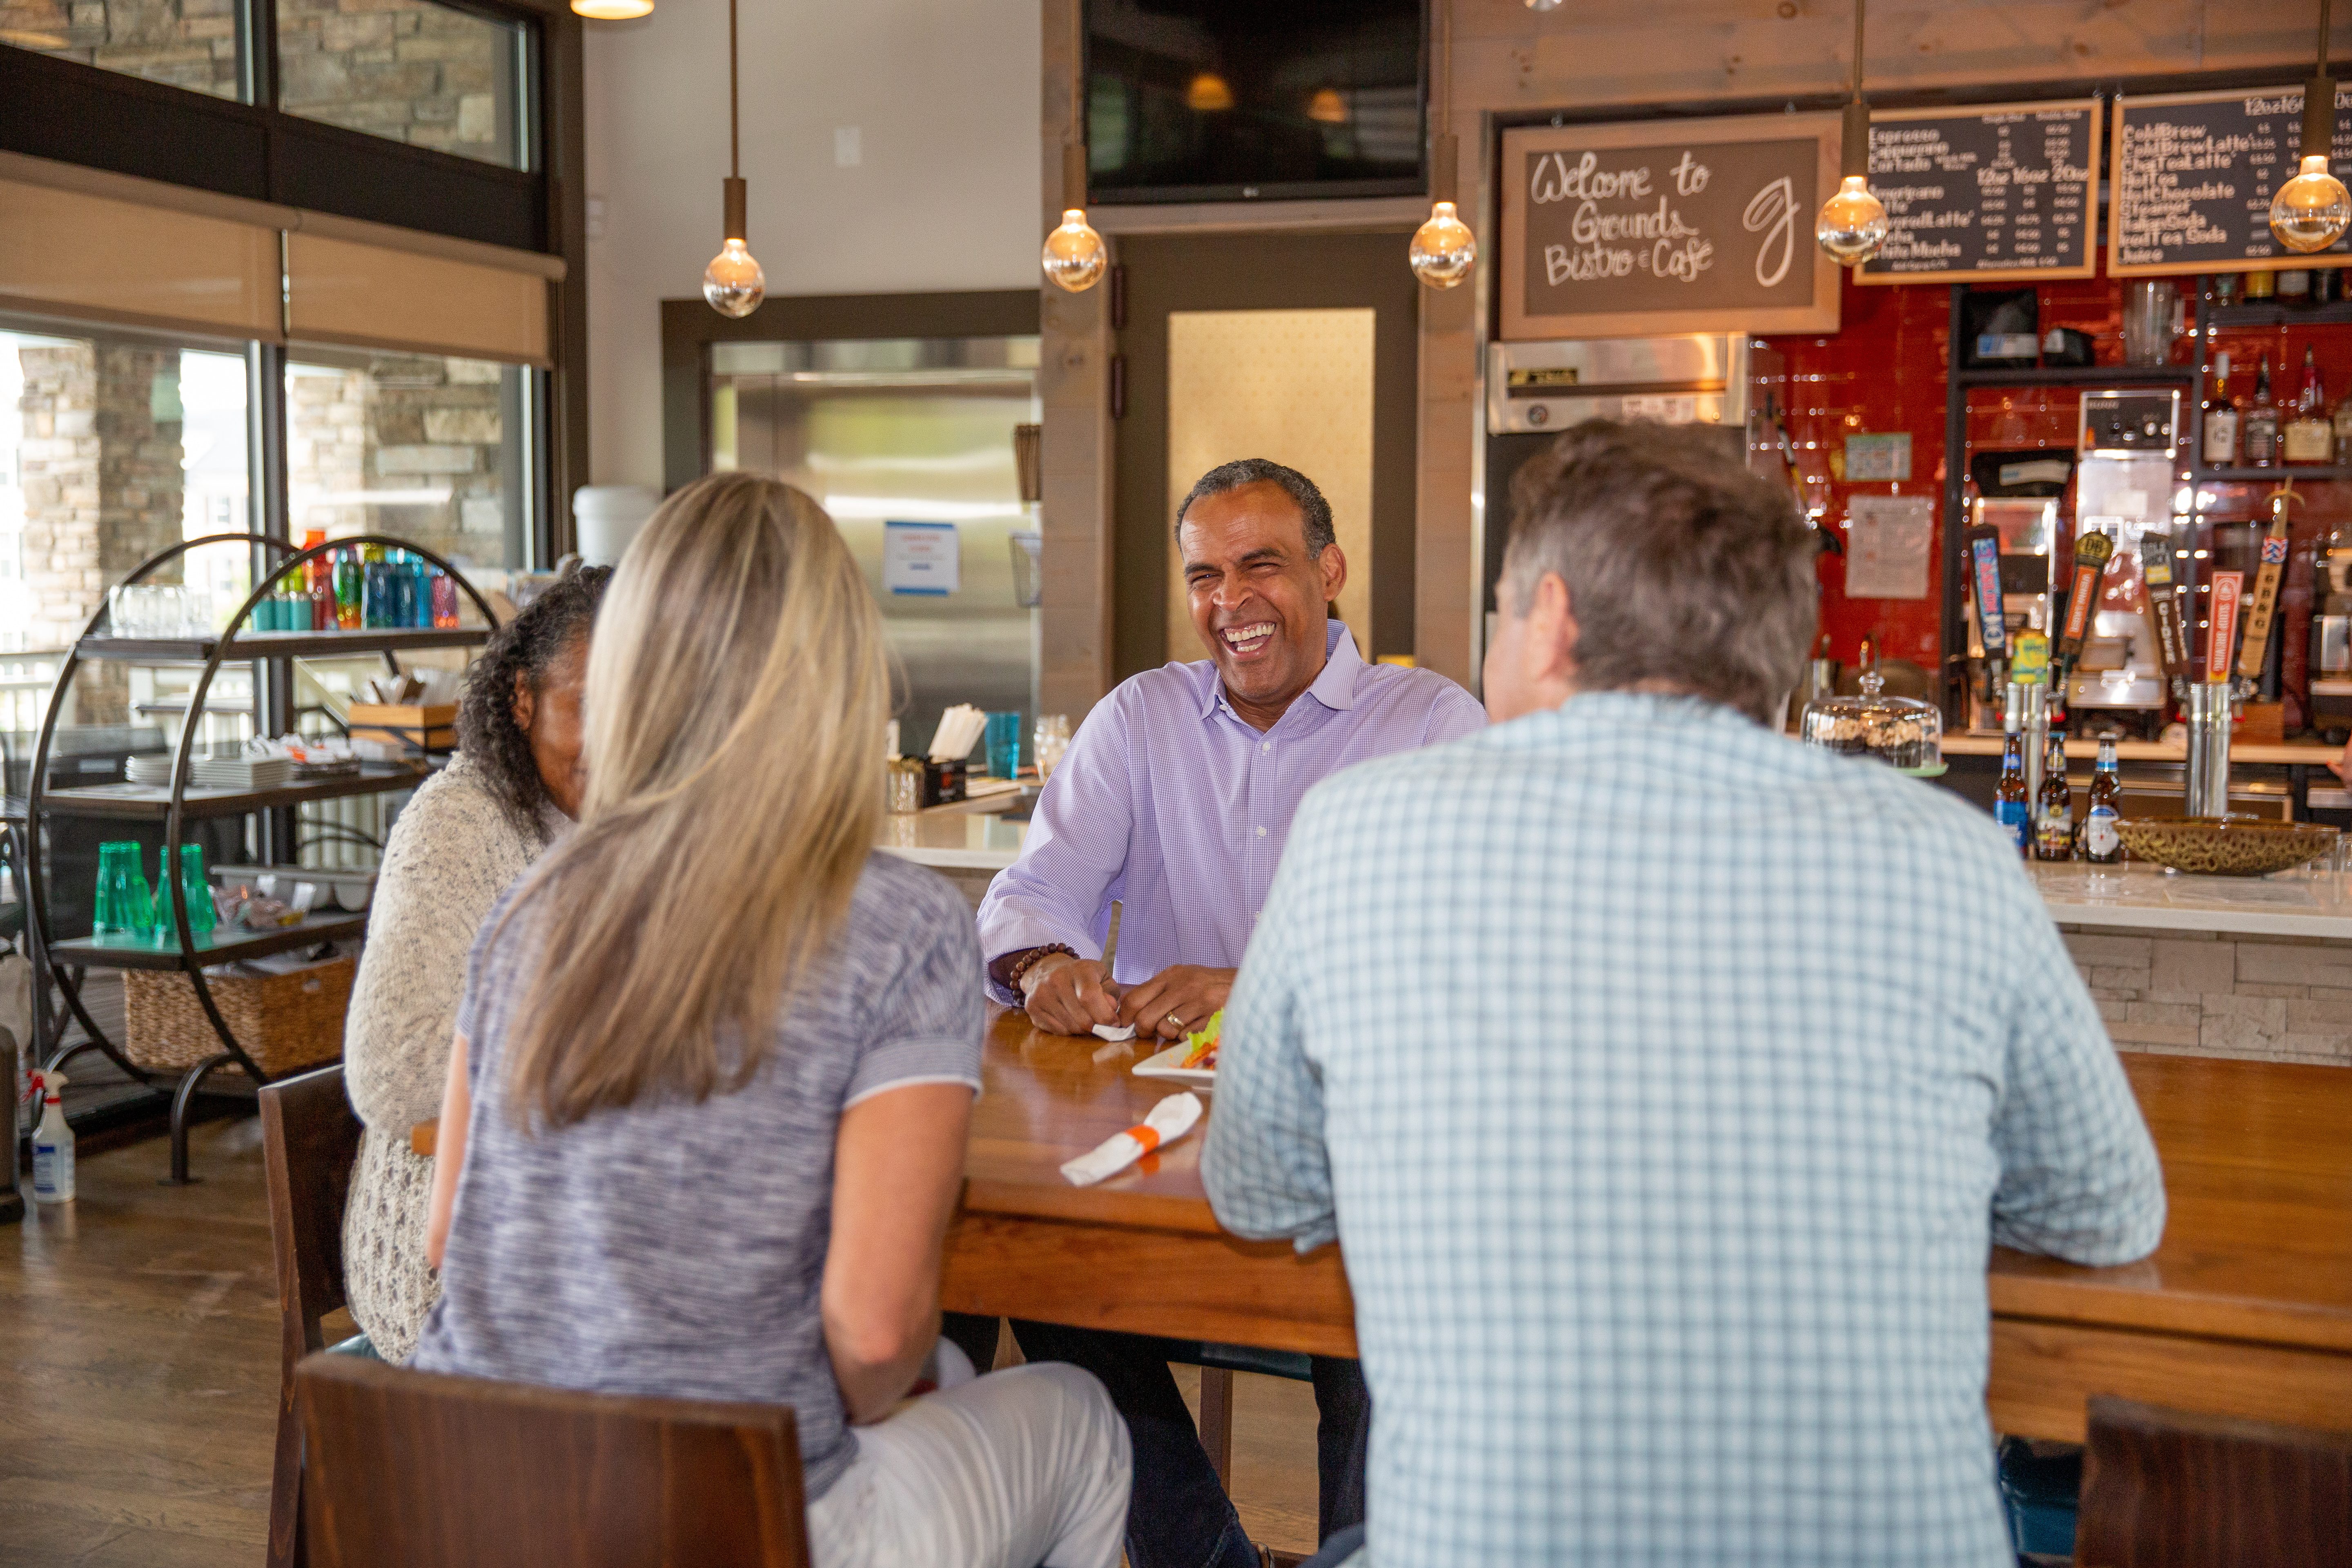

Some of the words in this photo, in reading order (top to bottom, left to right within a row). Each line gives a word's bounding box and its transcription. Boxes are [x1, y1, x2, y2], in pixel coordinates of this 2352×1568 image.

[1530, 152, 1653, 204] Welcome
[1669, 150, 1710, 196] to
[1572, 195, 1699, 244] Grounds
[1545, 245, 1633, 286] Bistro
